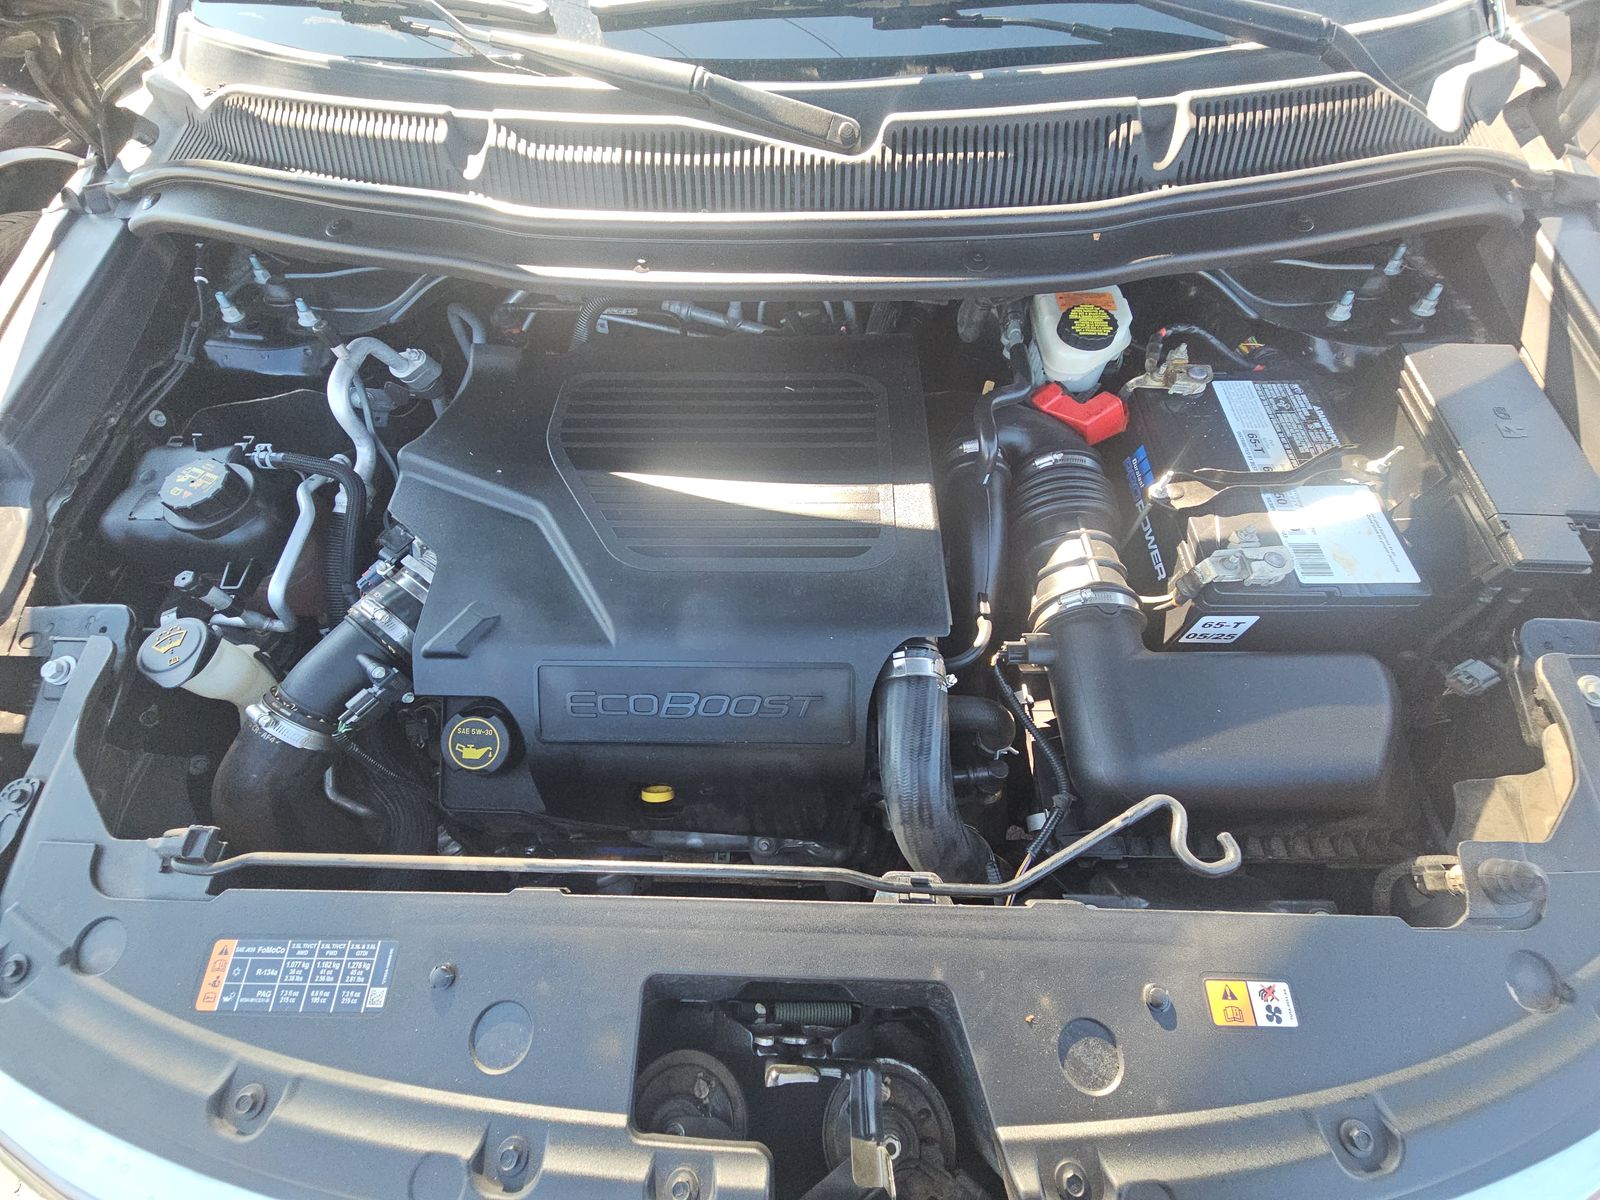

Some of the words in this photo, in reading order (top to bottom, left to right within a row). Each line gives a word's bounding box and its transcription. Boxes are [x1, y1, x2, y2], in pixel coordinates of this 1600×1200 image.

[1247, 433, 1265, 454] 65-T
[1131, 457, 1145, 489] Duralast
[1201, 621, 1247, 629] 65-T
[1185, 632, 1238, 641] 05/25
[457, 727, 470, 735] SAE
[471, 728, 493, 736] 5W-30
[257, 946, 286, 954] FoMoCo
[301, 961, 310, 970] kg
[332, 961, 340, 970] kg
[363, 962, 371, 971] kg
[256, 968, 279, 976] R-134a
[256, 990, 272, 998] PAG
